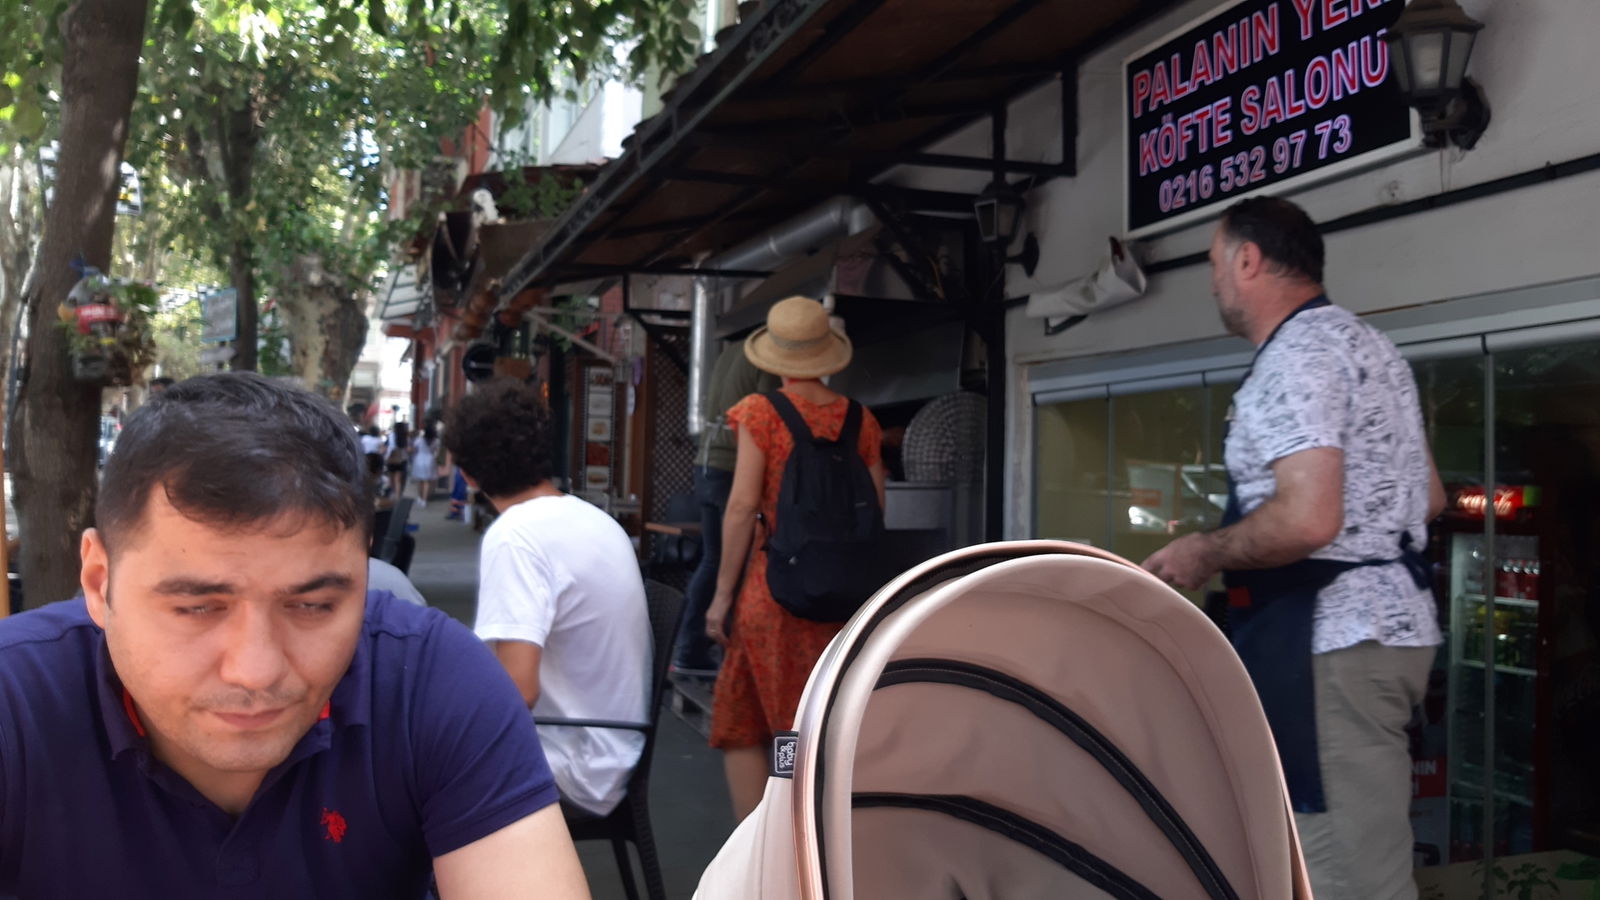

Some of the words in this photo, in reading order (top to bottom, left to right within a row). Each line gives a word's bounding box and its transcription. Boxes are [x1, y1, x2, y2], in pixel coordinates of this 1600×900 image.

[1132, 2, 1280, 119] PALANIN
[1292, 0, 1390, 41] YE
[1139, 96, 1232, 177] KÖFTE
[1240, 28, 1388, 136] SALONU
[1159, 165, 1213, 213] 0216
[1219, 145, 1266, 193] 532
[1272, 129, 1308, 176] 97
[1315, 113, 1351, 160] 73
[784, 741, 796, 766] baby
